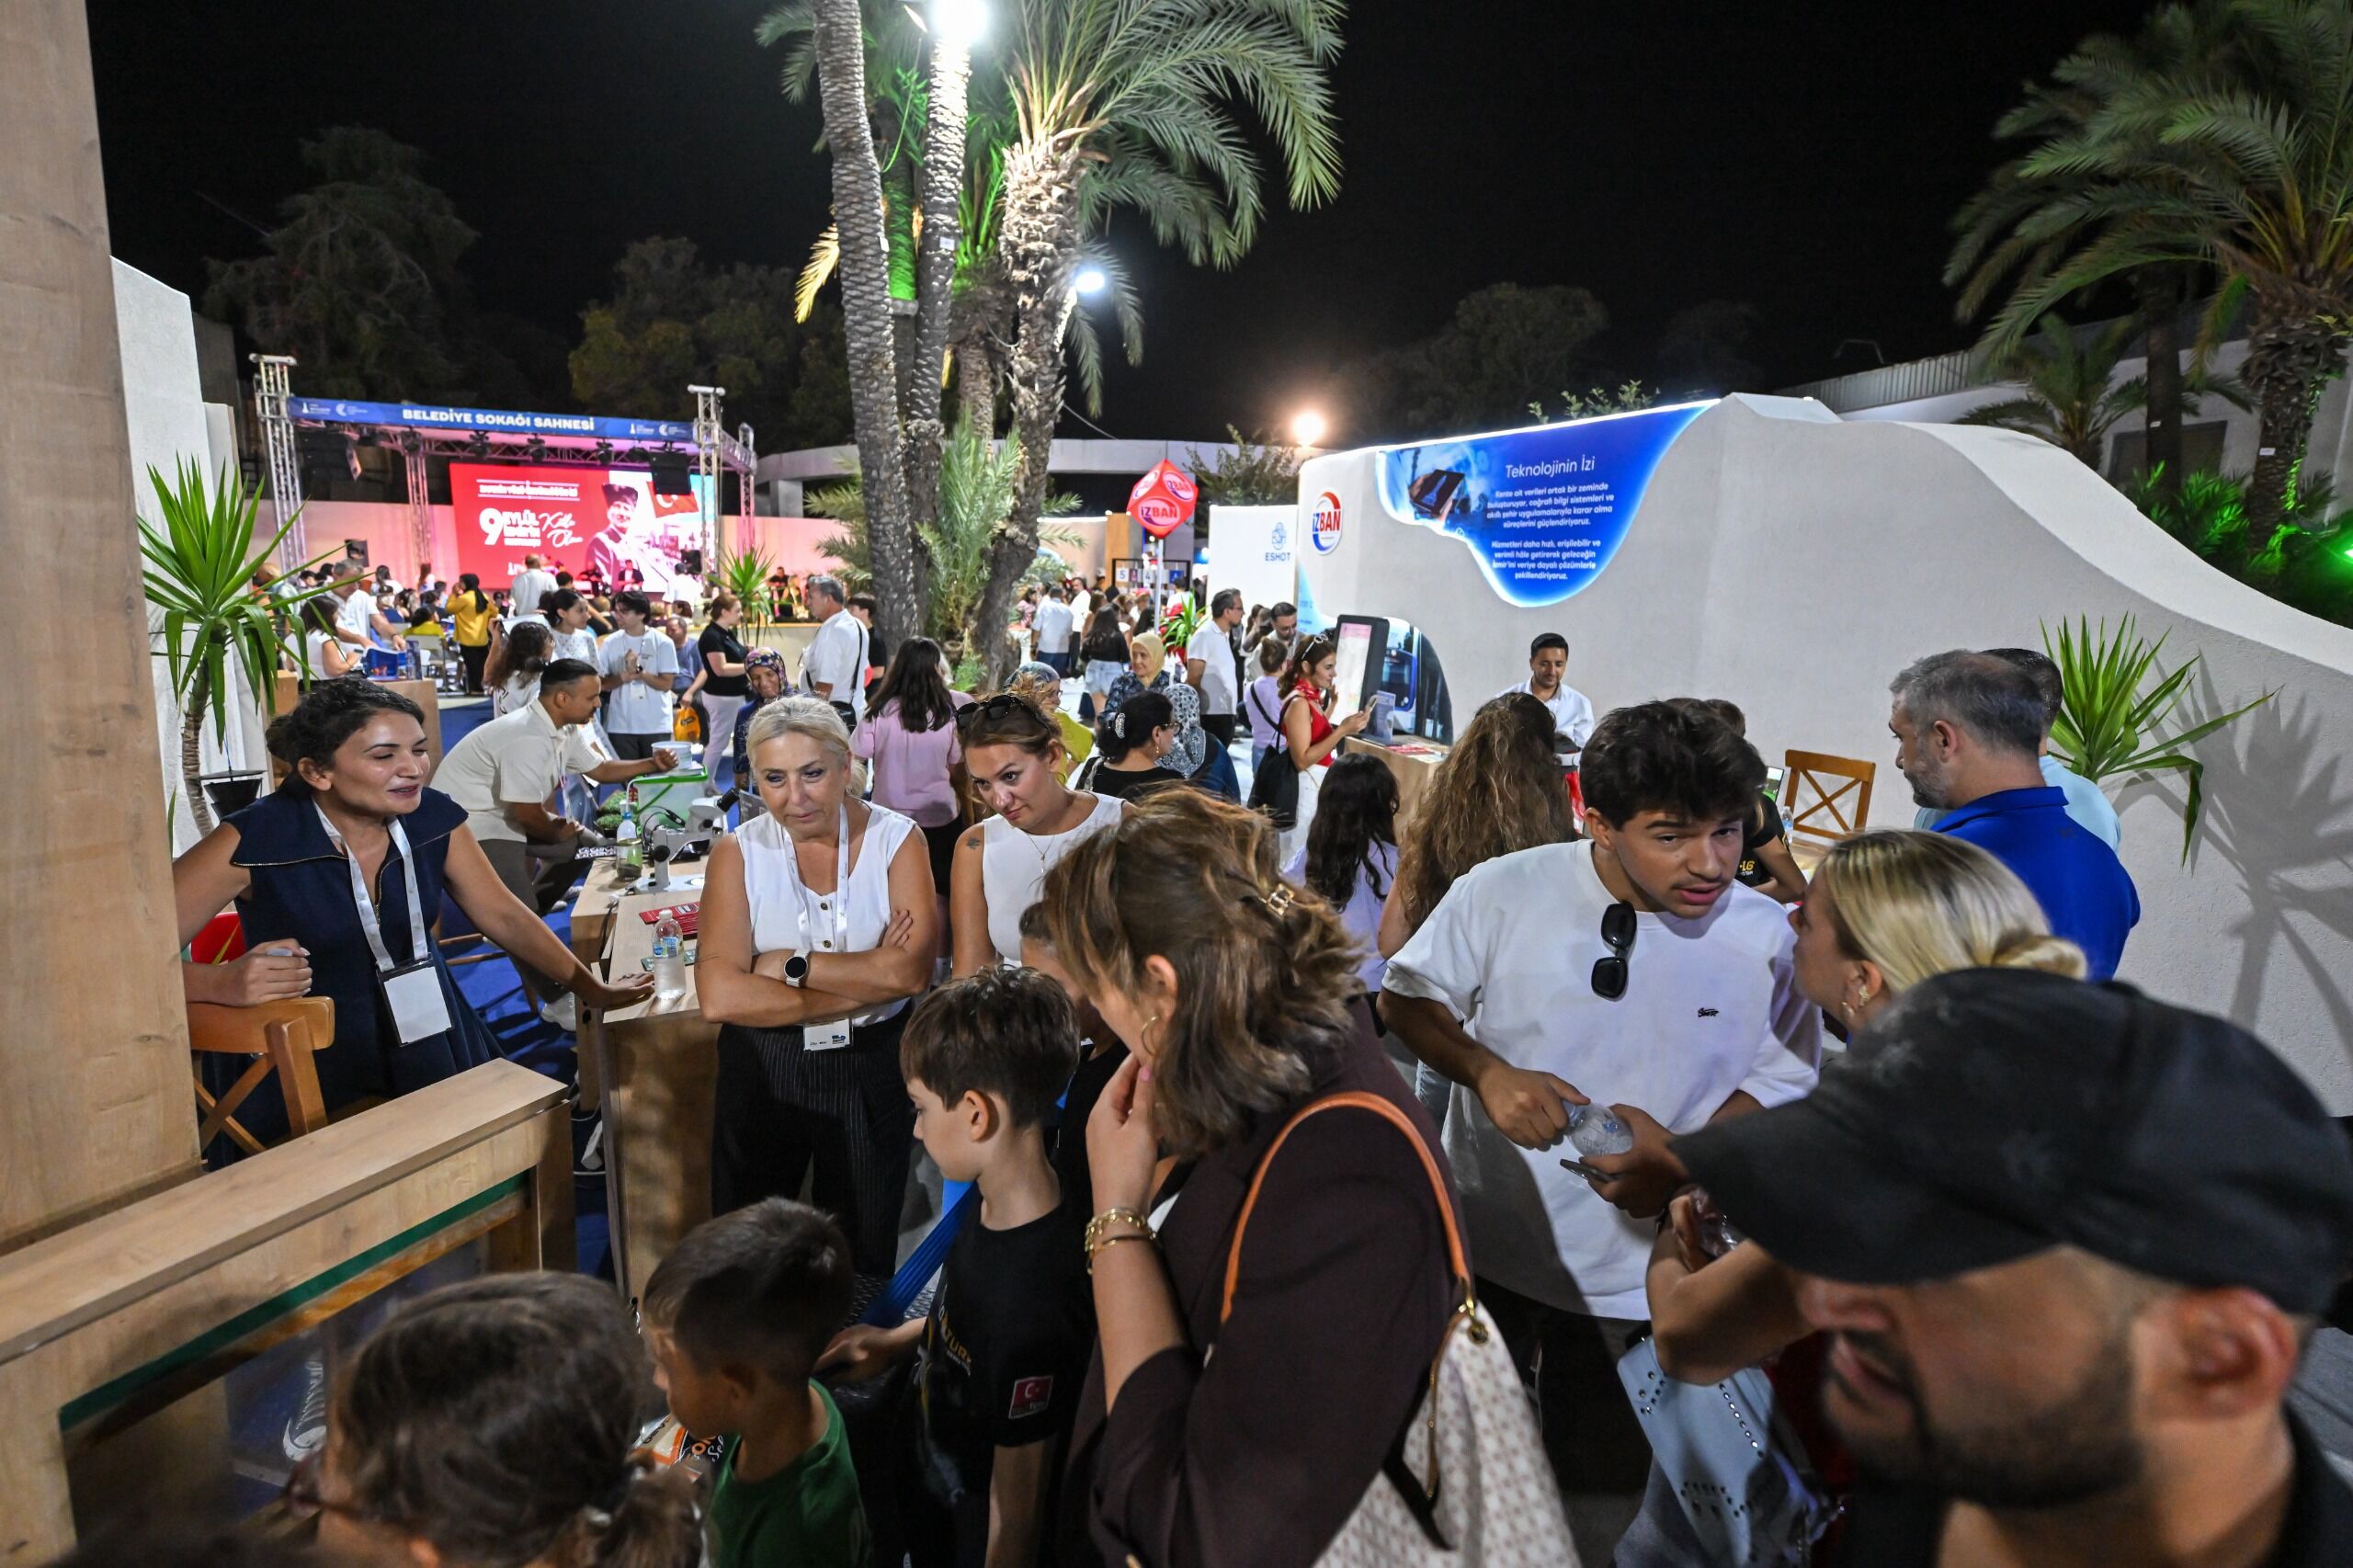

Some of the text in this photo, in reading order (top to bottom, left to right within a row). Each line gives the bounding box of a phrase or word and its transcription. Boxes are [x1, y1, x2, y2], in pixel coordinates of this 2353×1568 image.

[403, 408, 595, 431] BELEDİYE SOKAĞI SAHNESİ
[1506, 454, 1596, 478] Teknolojinin İzi
[1525, 487, 1546, 496] verileri
[1548, 485, 1566, 494] ortak
[1567, 484, 1577, 493] bir
[1578, 482, 1608, 492] zeminde
[1529, 497, 1553, 507] coğrafi
[1553, 496, 1569, 506] bilgi
[1570, 494, 1605, 505] sistemleri
[1606, 494, 1615, 502] ve
[1573, 506, 1593, 515] karar
[1594, 505, 1613, 513] alma
[479, 507, 503, 545] 9
[1265, 551, 1290, 562] ESHOT
